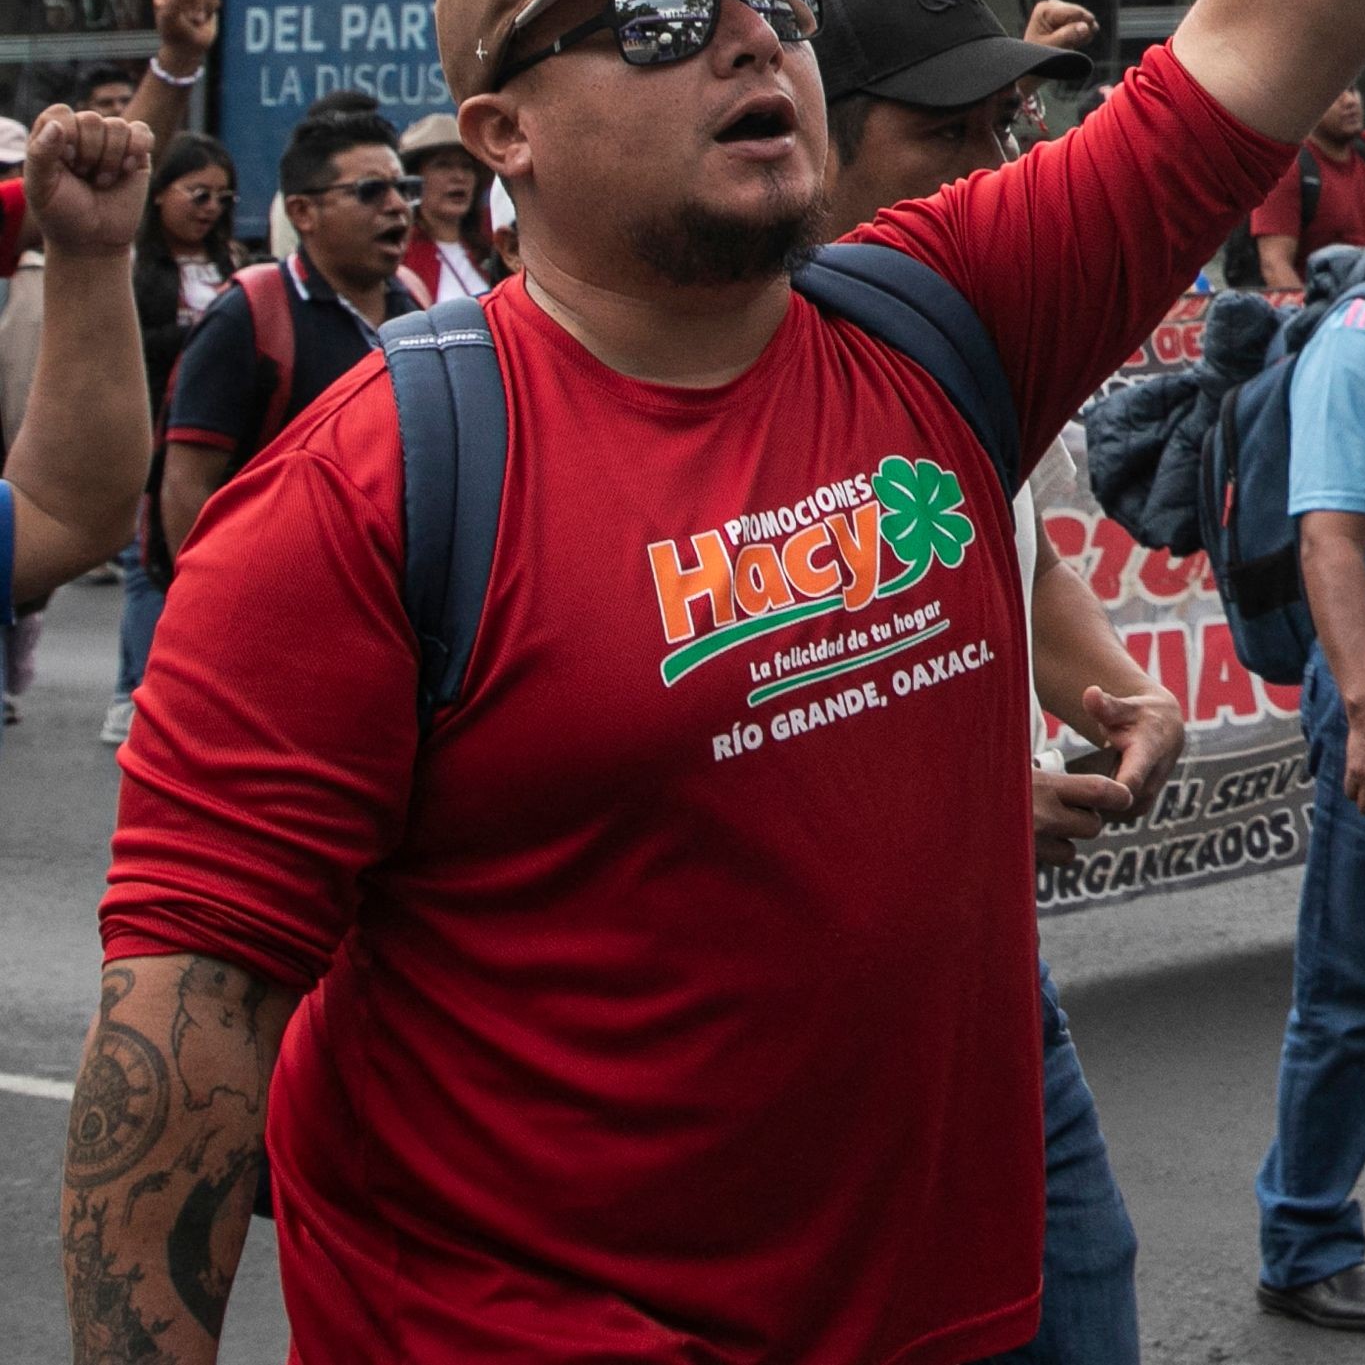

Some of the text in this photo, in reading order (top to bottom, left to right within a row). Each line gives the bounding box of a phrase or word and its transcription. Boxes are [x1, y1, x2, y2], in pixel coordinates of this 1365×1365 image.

[245, 2, 436, 54] DEL PAR
[260, 66, 304, 107] LA
[724, 473, 873, 545] PROMOCIONES
[647, 500, 881, 644] Hacy
[749, 600, 942, 682] La felicidad de tu hogar
[712, 721, 764, 762] RÍO
[770, 681, 888, 741] GRANDE,
[892, 640, 995, 696] OAXACA.
